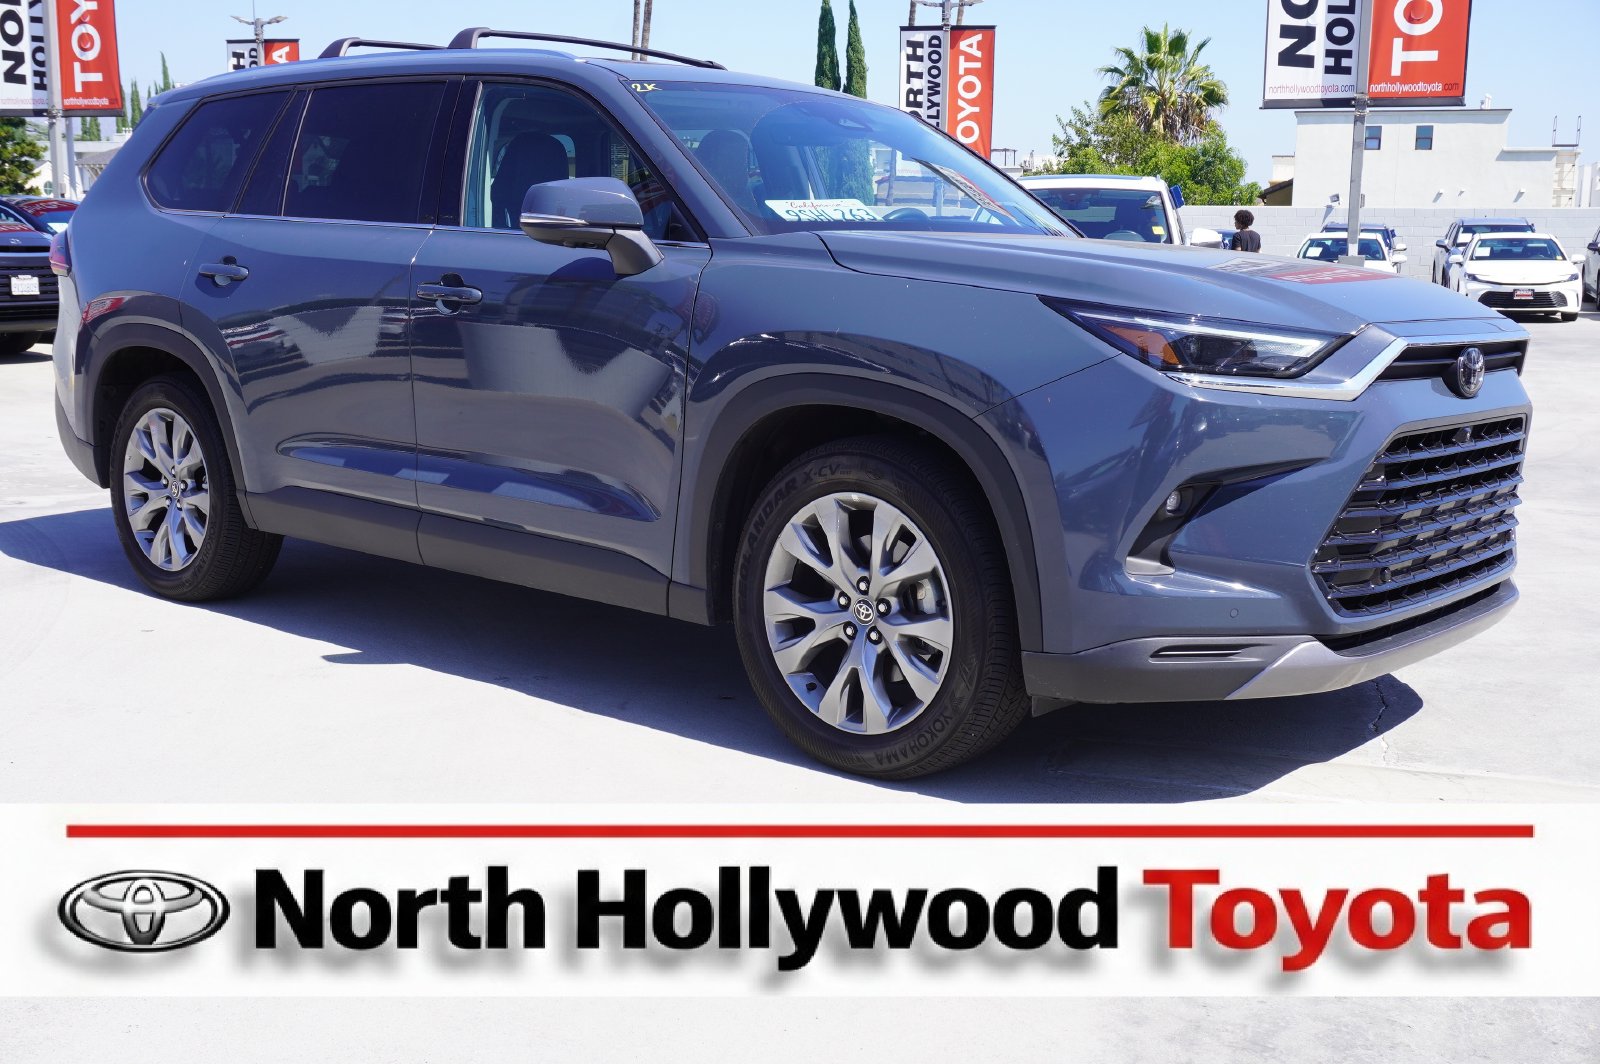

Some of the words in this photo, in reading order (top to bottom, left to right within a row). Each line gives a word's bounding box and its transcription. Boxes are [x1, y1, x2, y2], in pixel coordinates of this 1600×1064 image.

[0, 0, 27, 85] NO
[70, 0, 103, 93] TOY
[1391, 0, 1444, 77] TO
[927, 35, 942, 127] LYWOOD
[956, 33, 983, 144] OYOTA
[1269, 83, 1355, 95] northhollywoodtoyota.com
[1369, 82, 1460, 95] northhollywoodtoyota.com
[873, 711, 953, 766] YOKOHAMA
